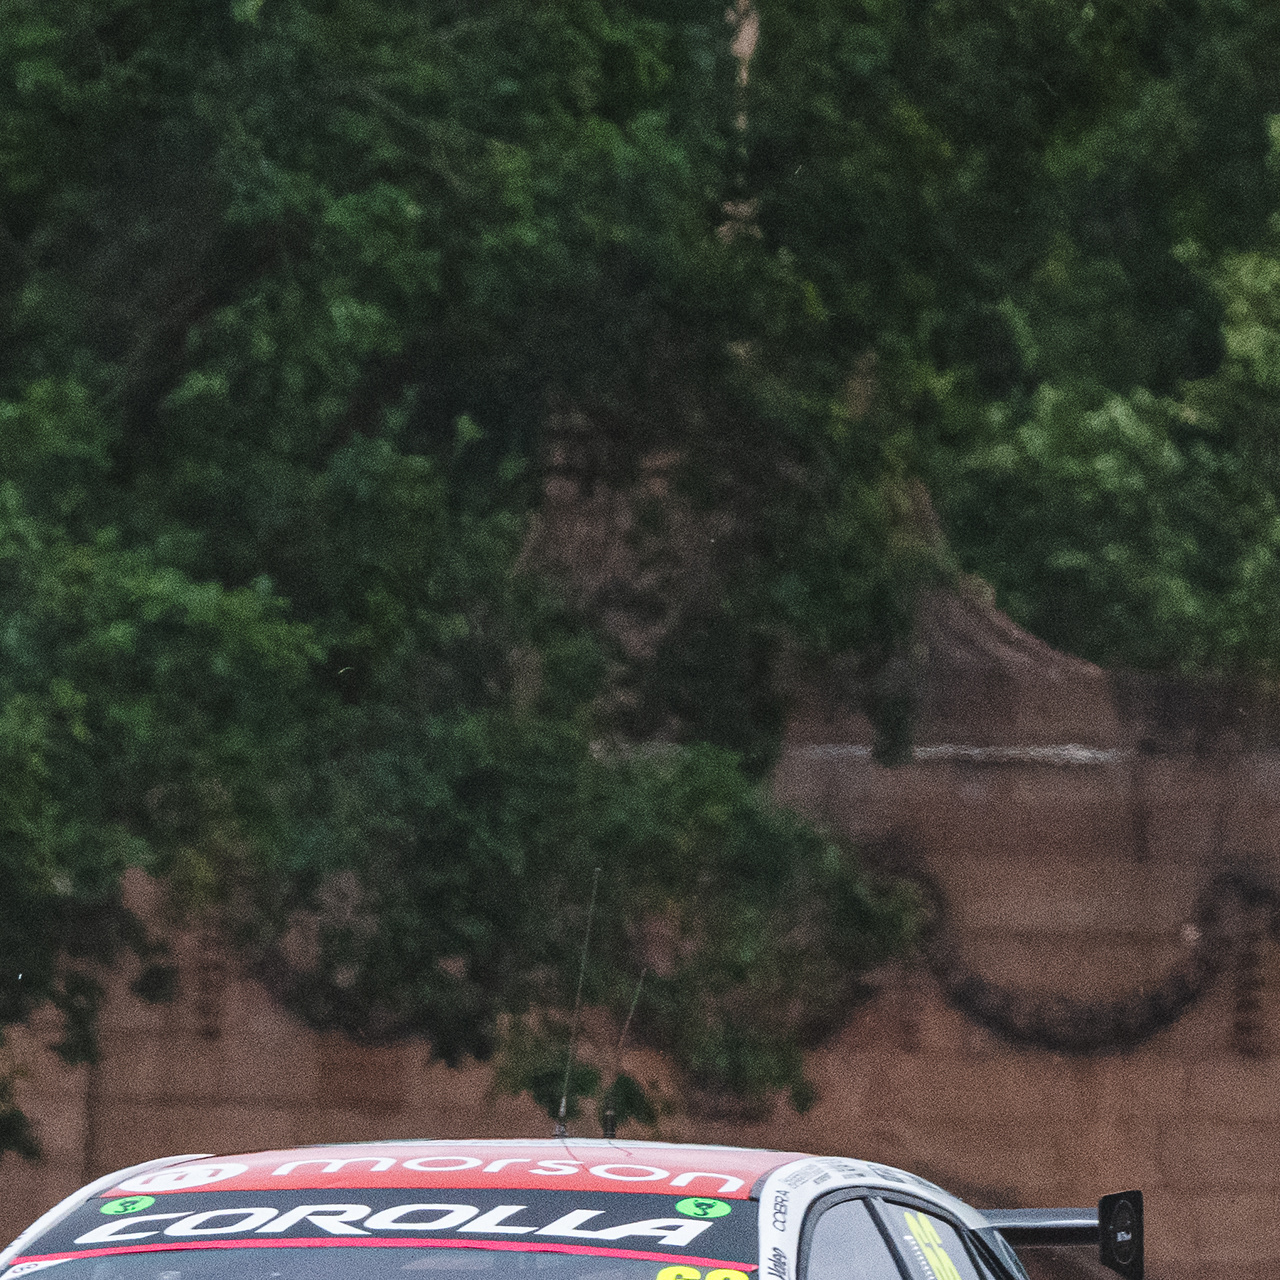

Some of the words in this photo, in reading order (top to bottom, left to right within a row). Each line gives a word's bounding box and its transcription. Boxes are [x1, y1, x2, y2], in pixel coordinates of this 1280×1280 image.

[271, 1156, 746, 1193] morson
[74, 1203, 714, 1247] COROLLA
[772, 1190, 790, 1232] COBRA
